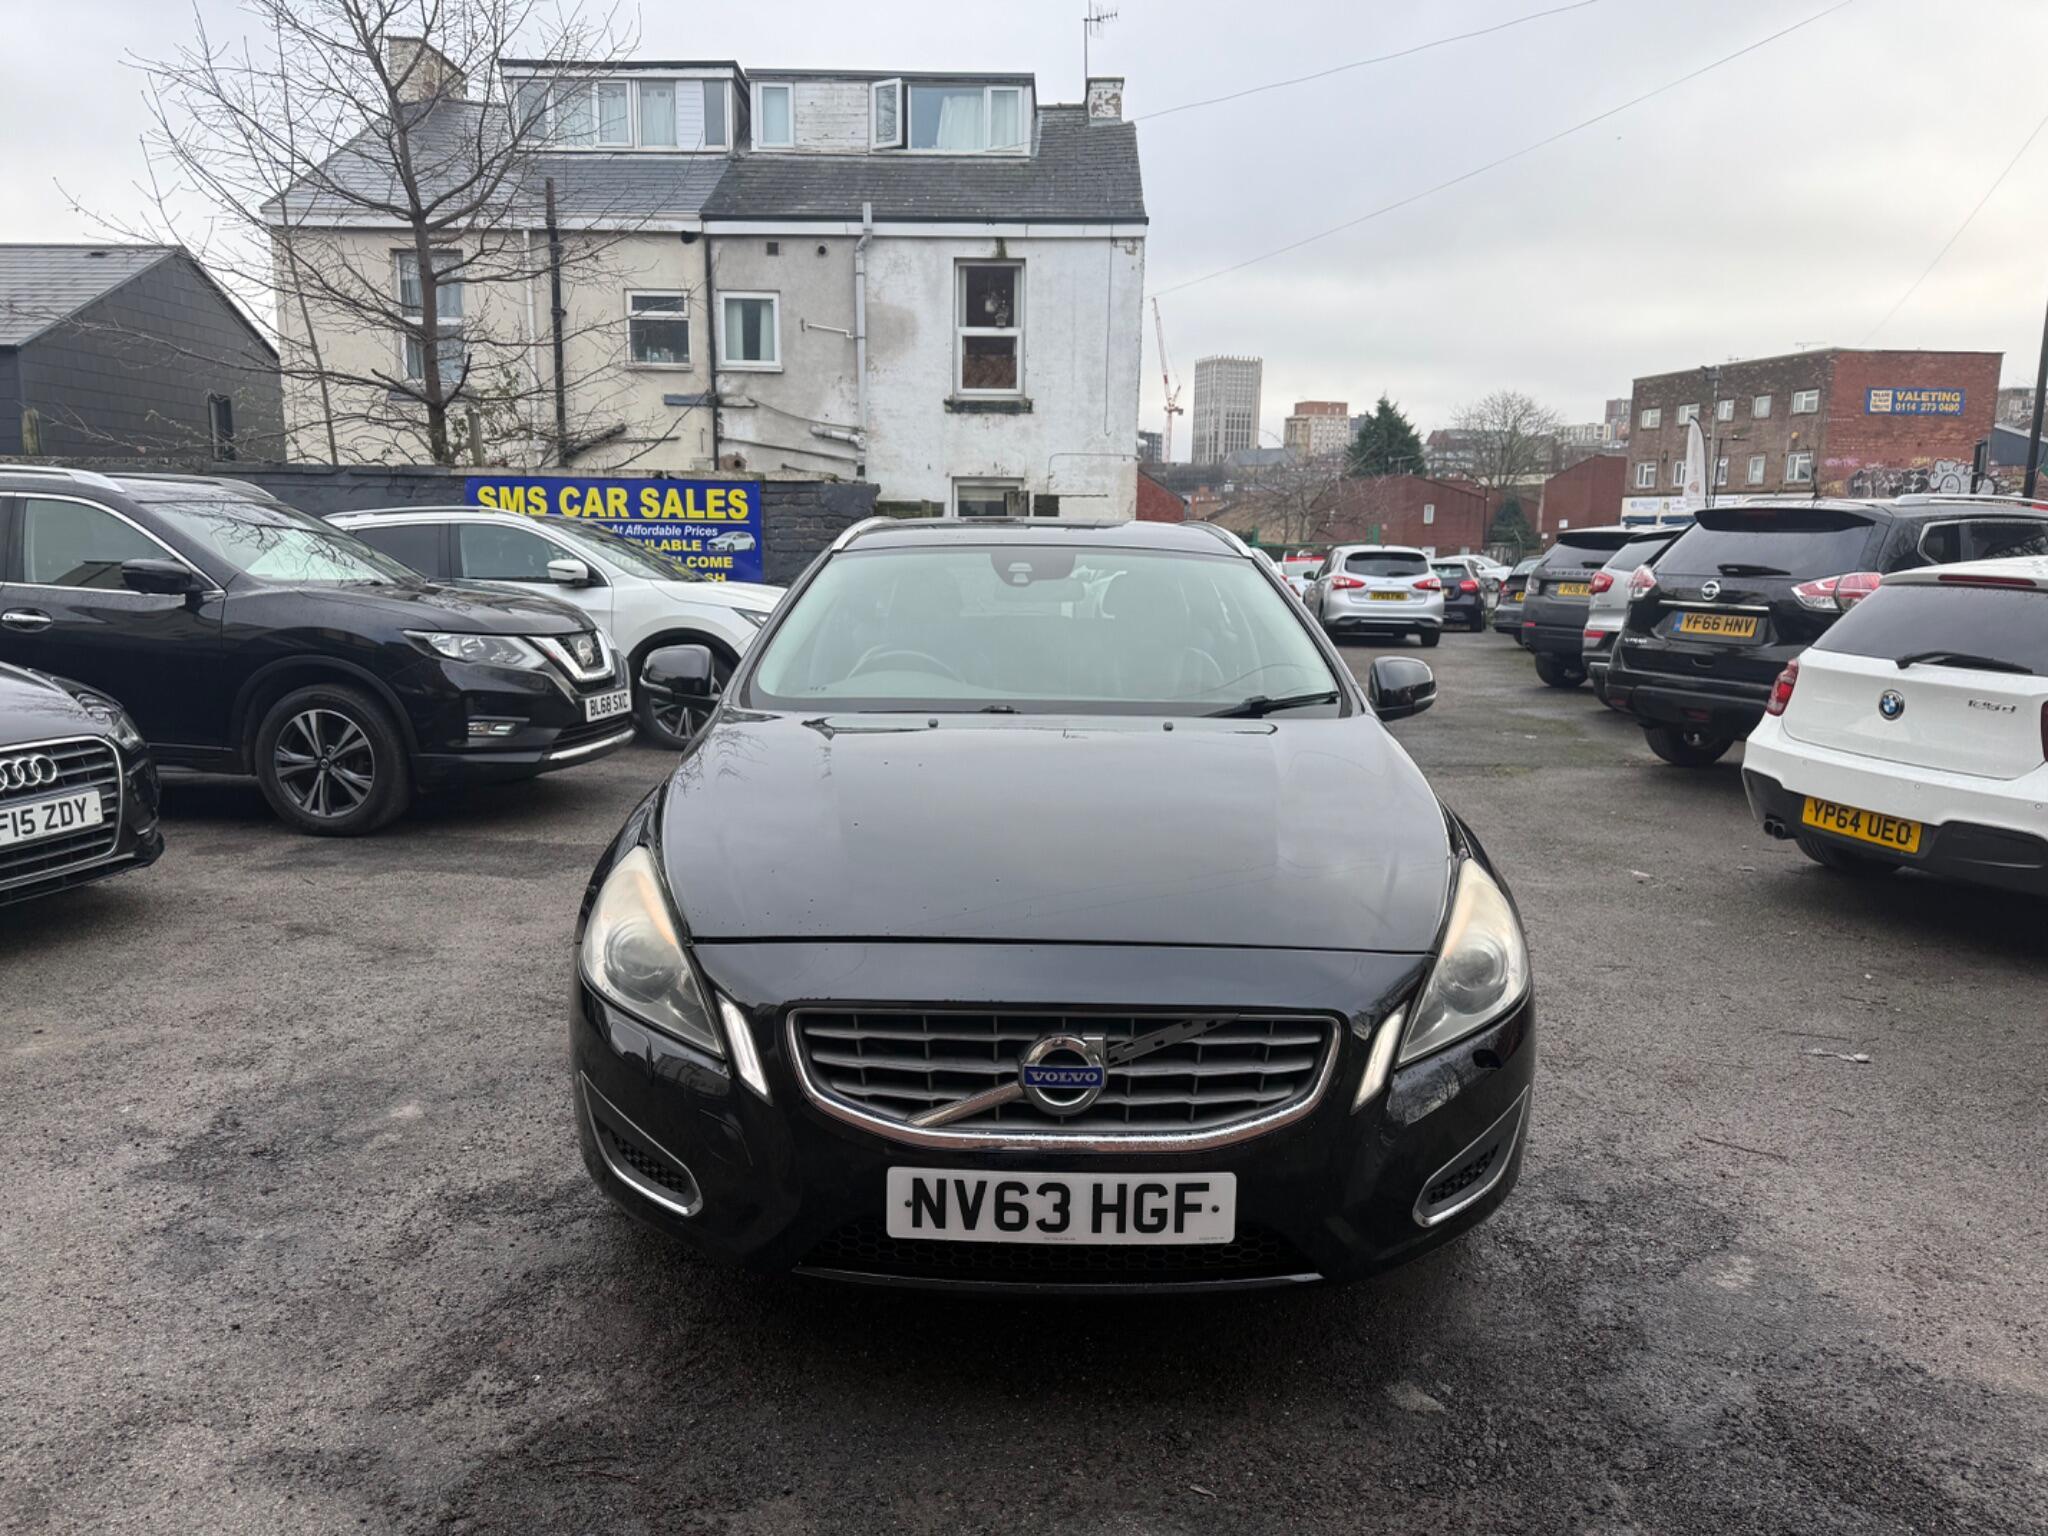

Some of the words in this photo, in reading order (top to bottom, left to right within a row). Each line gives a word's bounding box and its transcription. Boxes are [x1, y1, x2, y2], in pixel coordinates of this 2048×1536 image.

[1896, 391, 1961, 401] VALETING
[1895, 402, 1916, 412] 0114
[477, 486, 549, 516] SMS
[559, 486, 630, 518] CAR
[639, 487, 749, 519] SALES
[625, 524, 683, 536] Affordable
[684, 525, 719, 537] Prices
[1686, 613, 1721, 631] YF66
[1723, 616, 1754, 633] HNV
[590, 696, 612, 717] BL68
[41, 797, 87, 830] ZDY
[1813, 799, 1862, 833] YP64
[1867, 814, 1913, 845] UEO
[1029, 1071, 1098, 1082] VOLVO
[911, 1177, 1071, 1232] NV63
[1091, 1182, 1210, 1234] HGF
